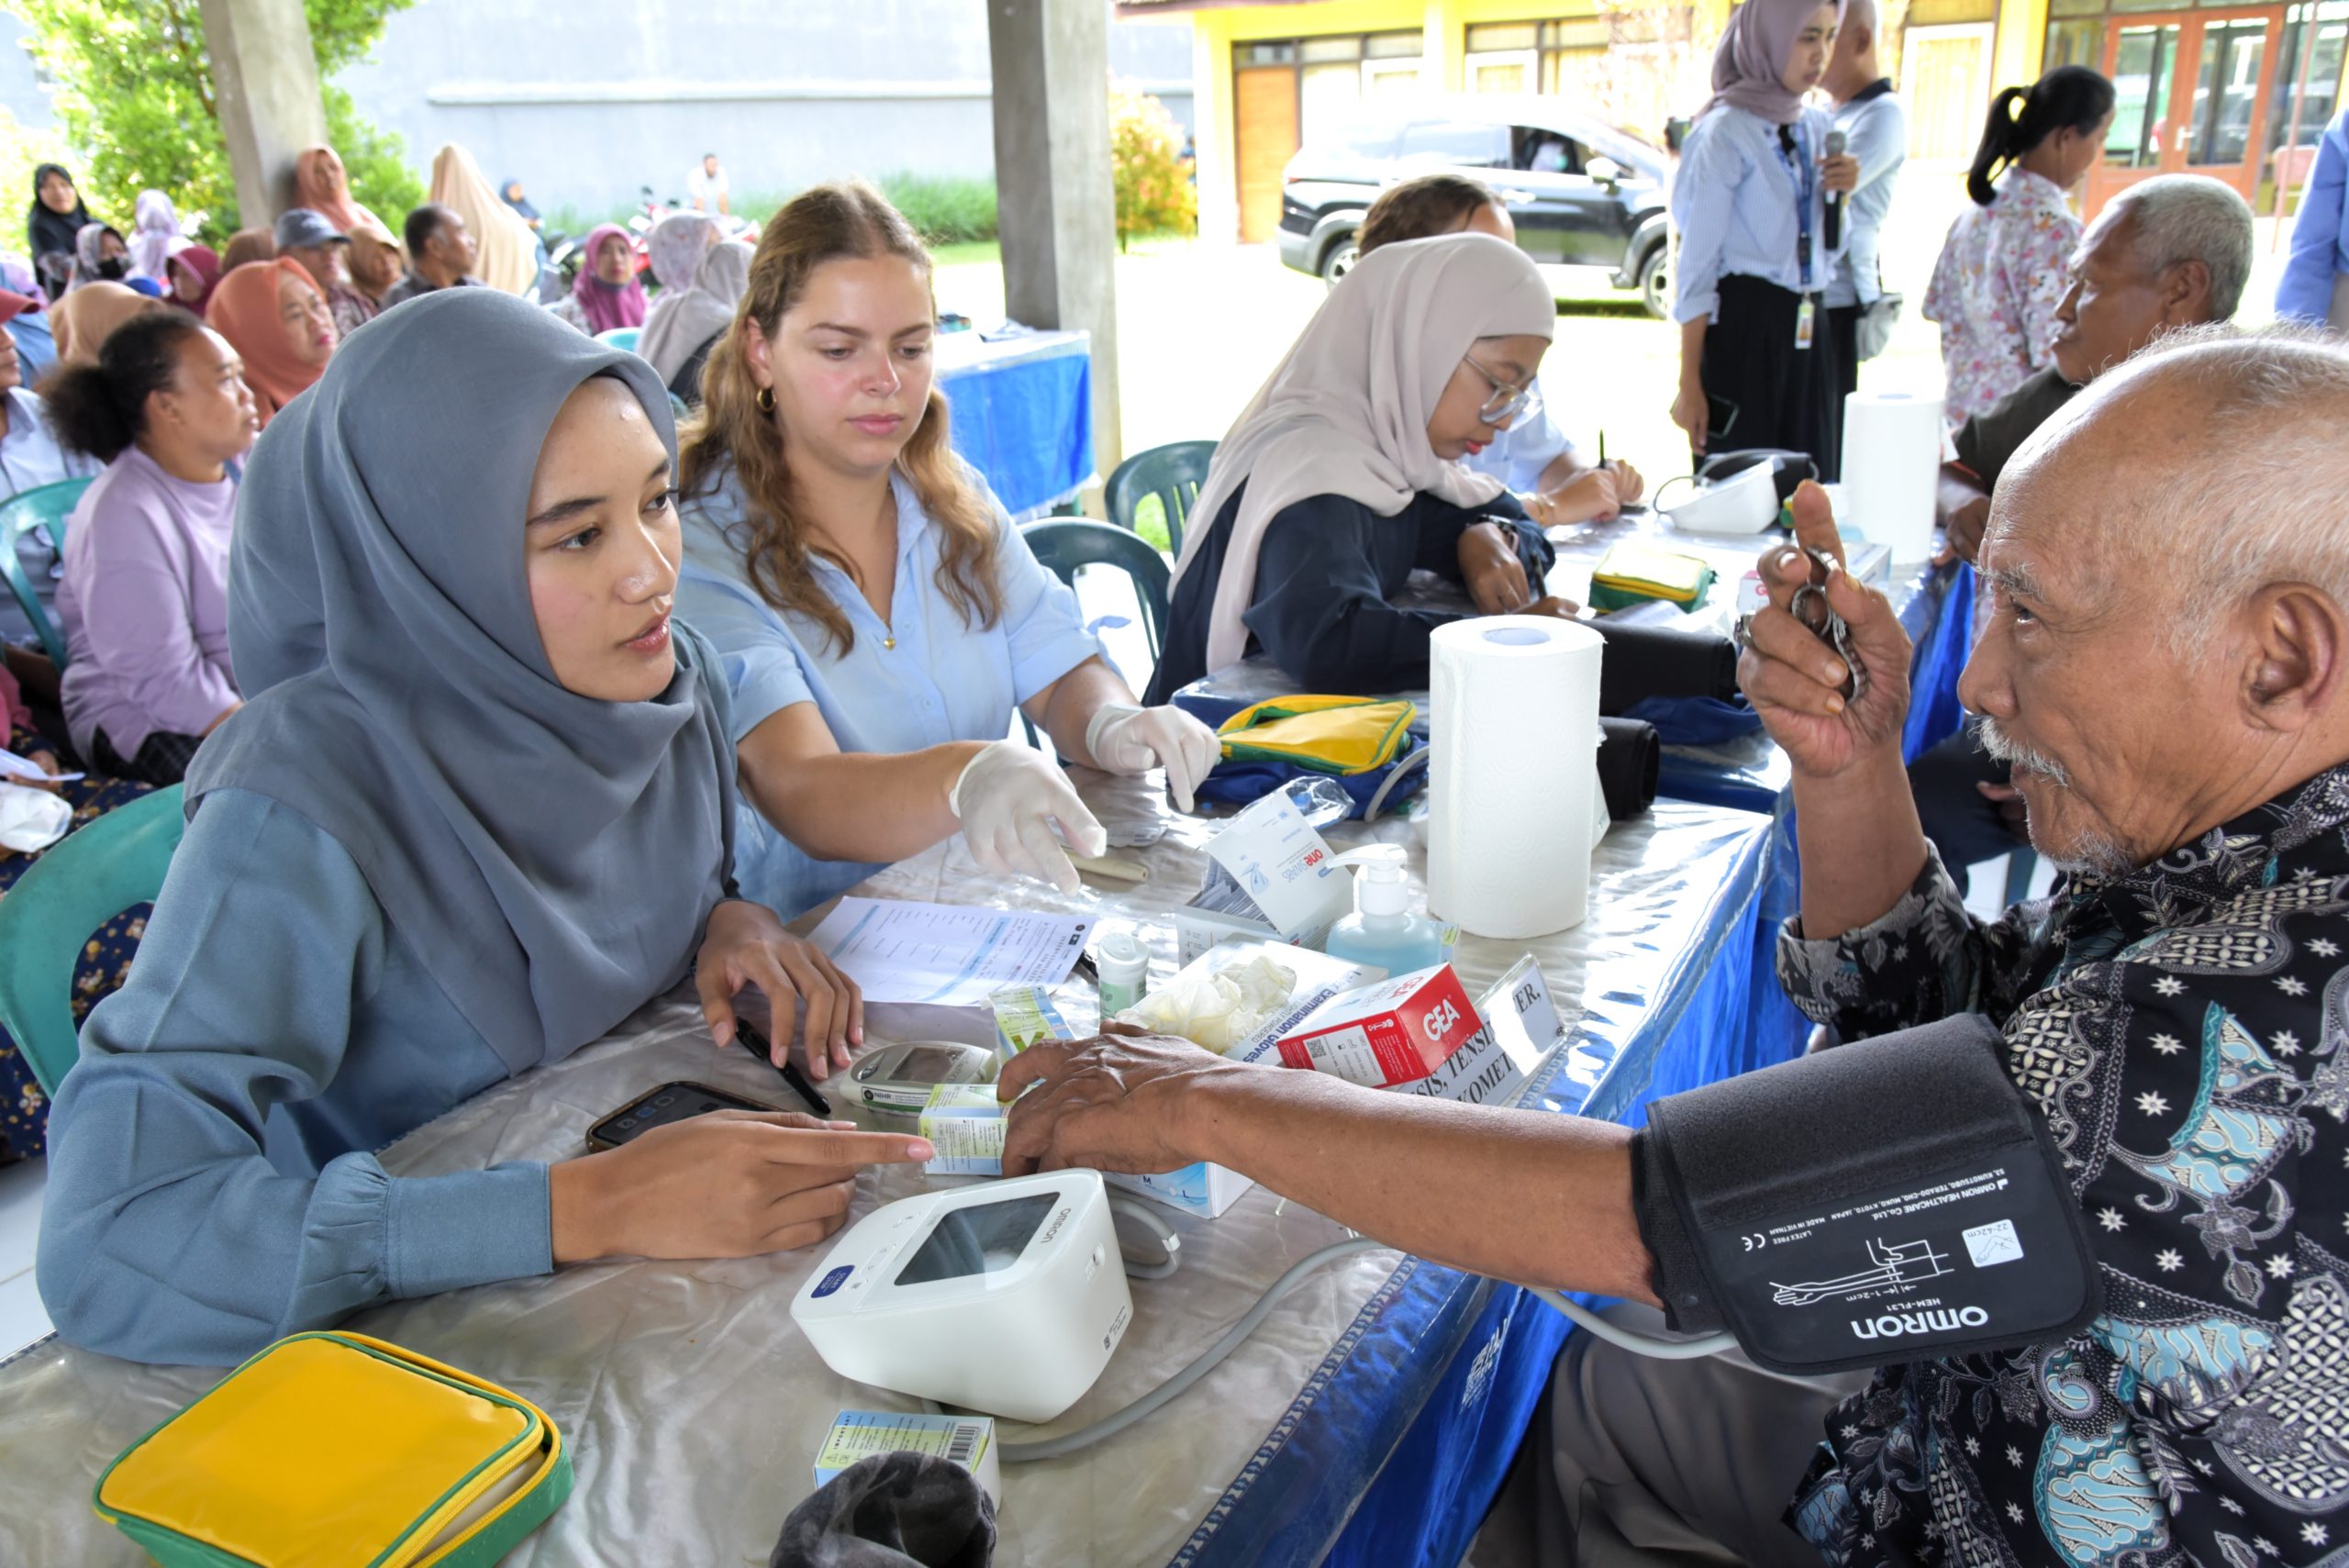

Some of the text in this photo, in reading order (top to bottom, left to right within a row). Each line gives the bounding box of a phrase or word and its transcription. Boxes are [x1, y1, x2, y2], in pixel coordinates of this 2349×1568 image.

[1303, 849, 1323, 866] one
[1279, 988, 1338, 1035] Examination
[1423, 998, 1461, 1041] GEA
[1251, 1016, 1284, 1043] POWDERED
[1242, 1033, 1280, 1063] Gloves
[1142, 1175, 1152, 1184] M
[1948, 1173, 1993, 1189] KUNOTSUBO,
[1183, 1189, 1189, 1198] L
[1901, 1184, 1949, 1202] TERADO-CHO,
[1961, 1183, 1997, 1198] OMRON
[1854, 1203, 1879, 1214] KYOTO,
[1878, 1197, 1901, 1208] MUKO,
[1904, 1193, 1961, 1214] HEALTHCARE
[1831, 1209, 1853, 1220] JAPAN
[1041, 1208, 1071, 1243] OMRON
[1769, 1217, 1826, 1236] MADE IN VIETNAM
[1772, 1230, 1812, 1245] LATEX FREE
[1845, 1290, 1881, 1302] 1-2cm
[1887, 1297, 1942, 1312] HEM-FL31
[1850, 1306, 1988, 1340] OMRON
[833, 1416, 852, 1450] IMPORTANT
